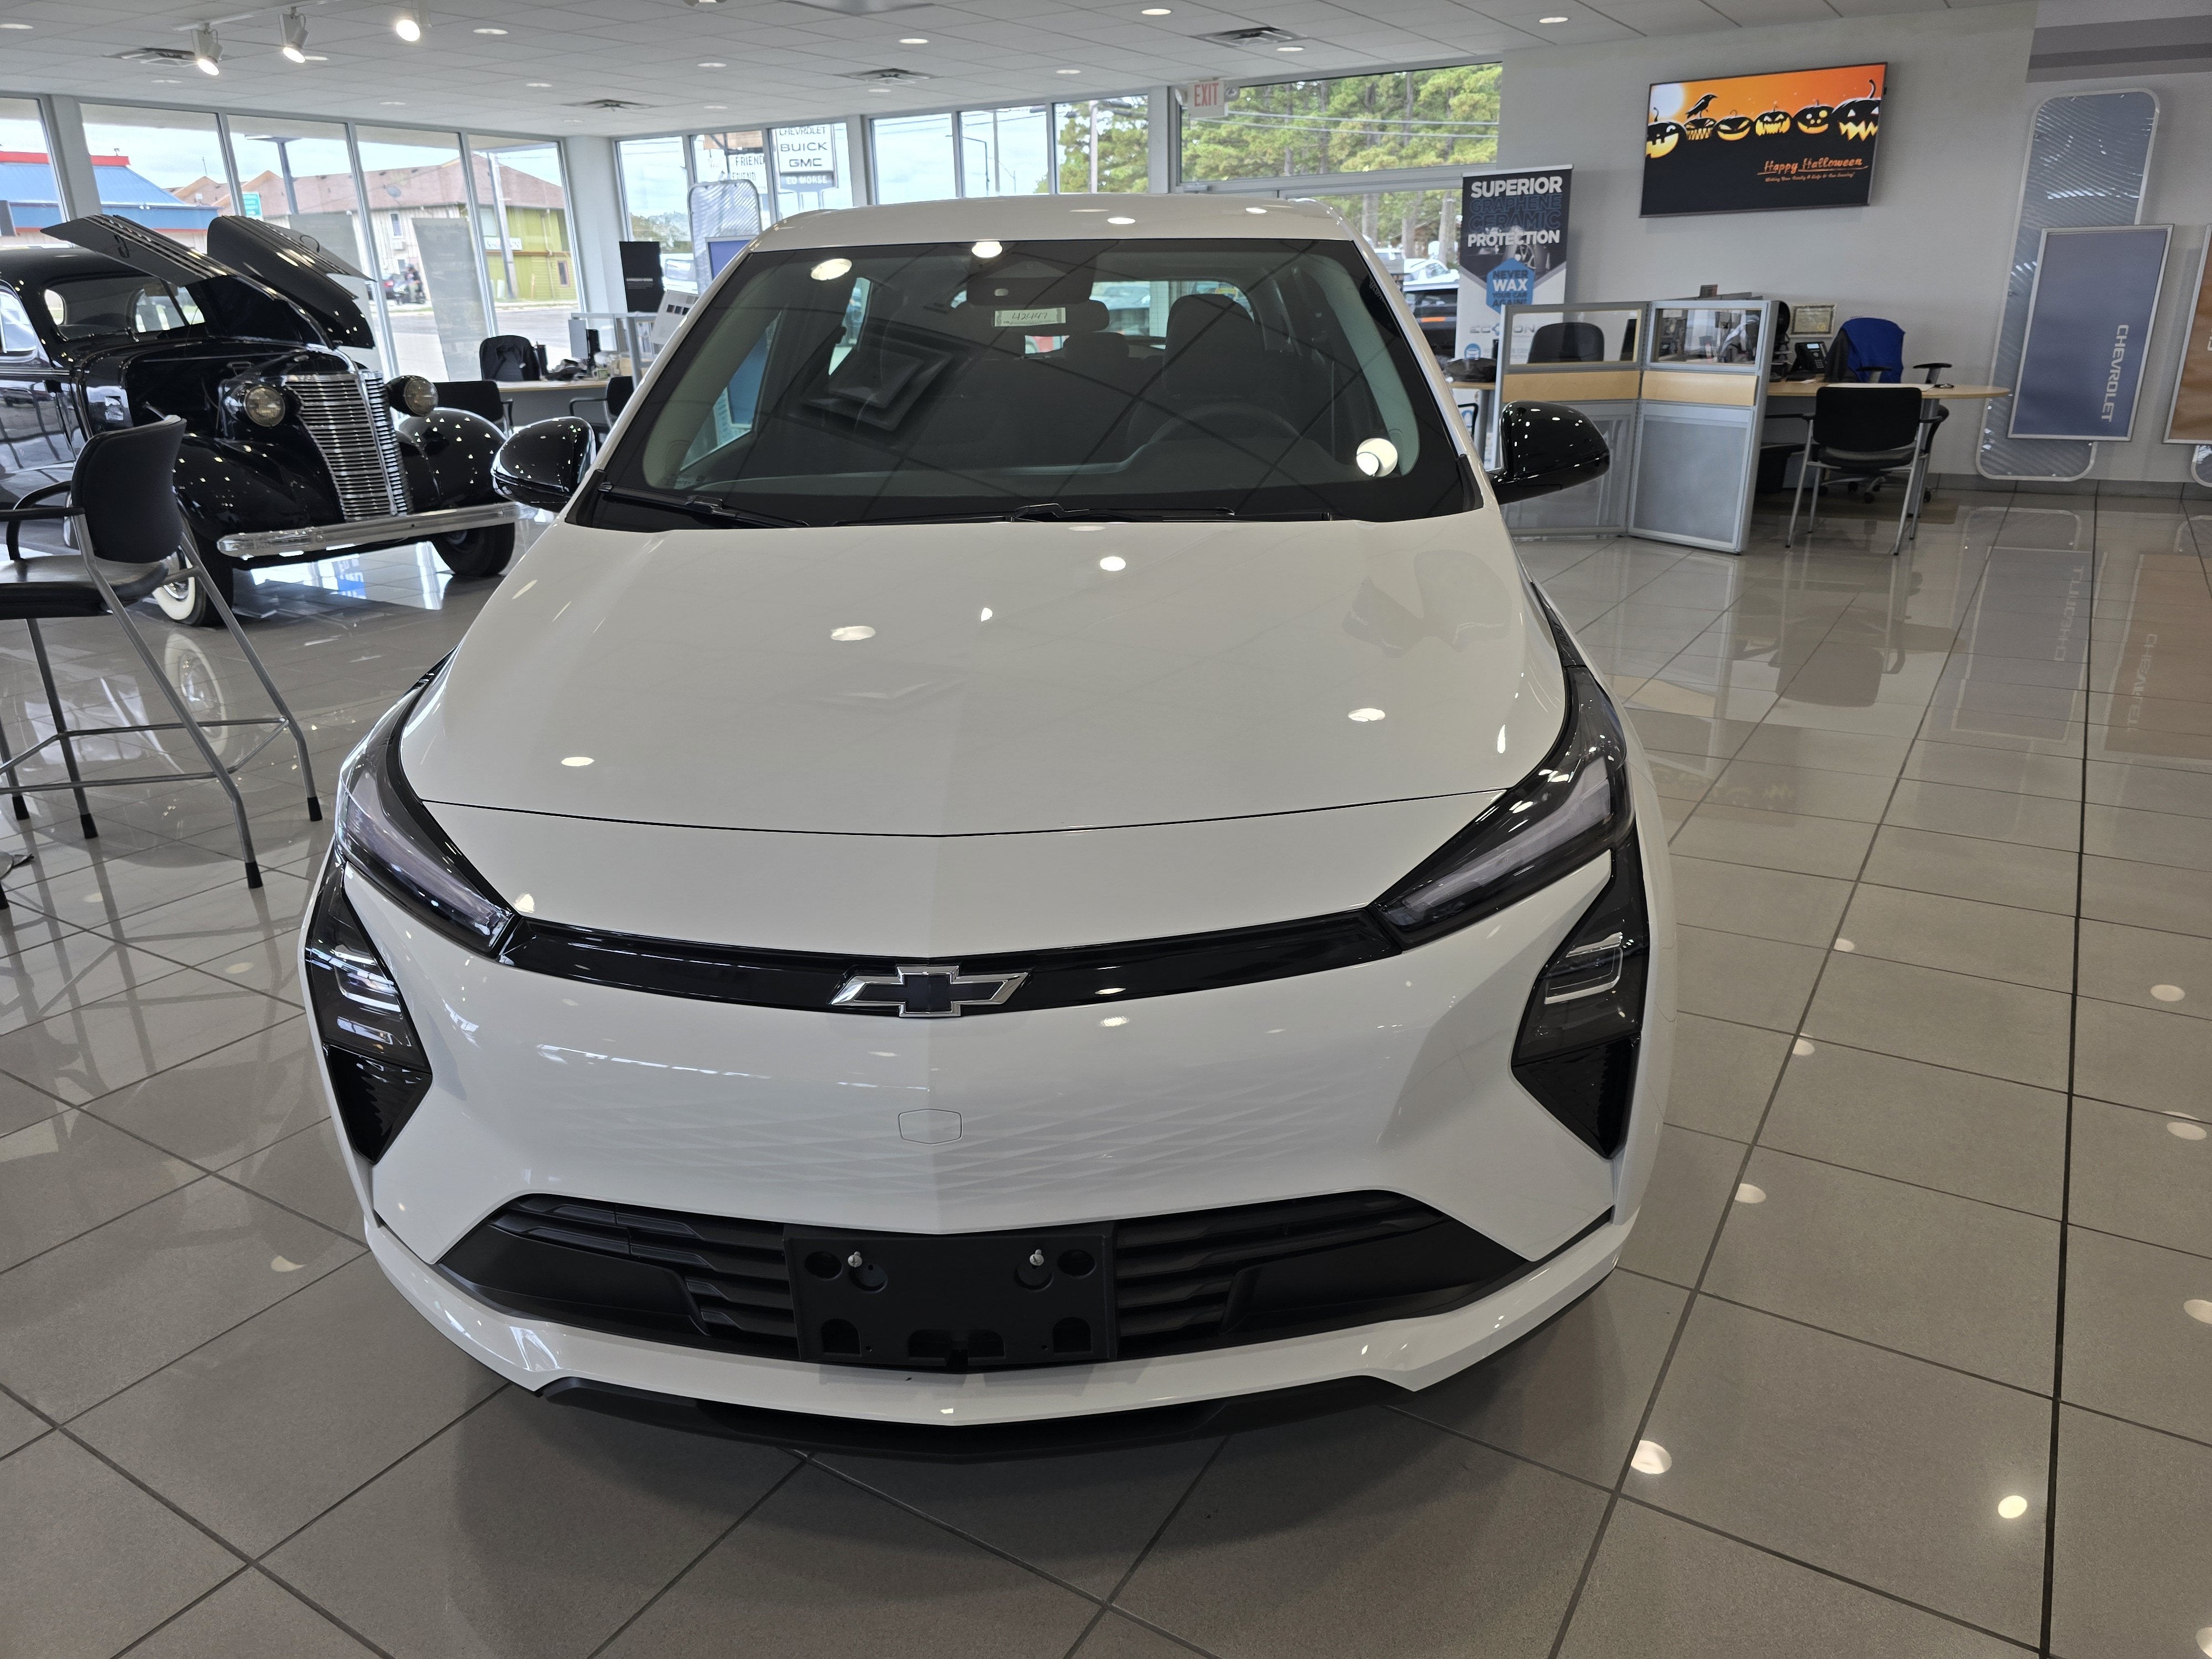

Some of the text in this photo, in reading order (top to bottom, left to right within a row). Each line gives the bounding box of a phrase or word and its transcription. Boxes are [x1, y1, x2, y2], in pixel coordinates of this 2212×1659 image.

[1194, 83, 1219, 107] EXIT
[780, 142, 828, 152] BUICK
[789, 158, 822, 167] GMC
[1764, 157, 1863, 174] Happy Halloween
[1470, 176, 1562, 198] SUPERIOR
[1469, 194, 1562, 214] GRAPHENE
[1468, 210, 1562, 233] CERAMIC
[1468, 229, 1560, 247] PROTECTION
[1493, 270, 1528, 279] NEVER
[1493, 279, 1528, 292] WAX
[2101, 325, 2129, 422] CHEVROLET
